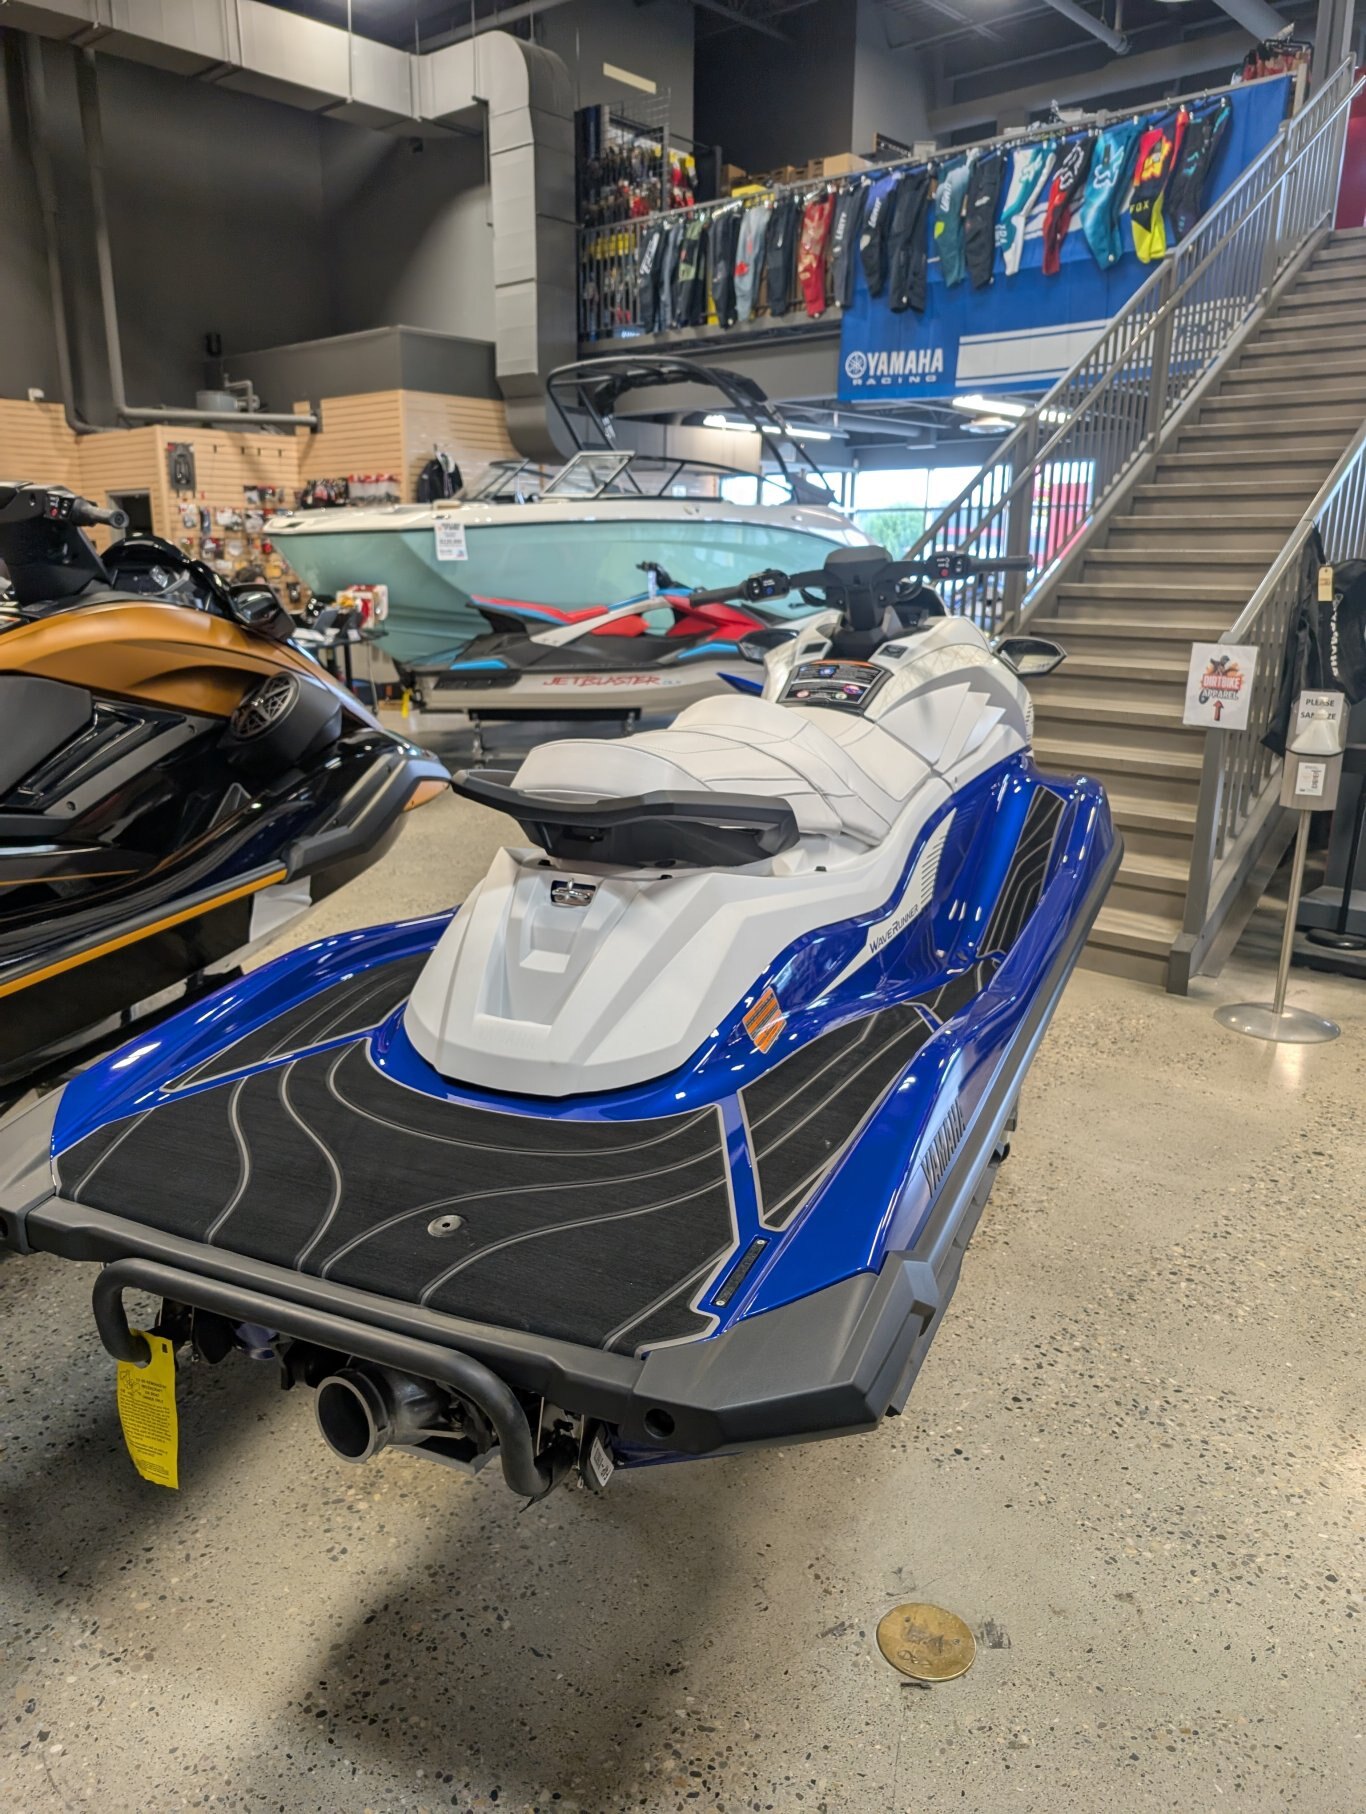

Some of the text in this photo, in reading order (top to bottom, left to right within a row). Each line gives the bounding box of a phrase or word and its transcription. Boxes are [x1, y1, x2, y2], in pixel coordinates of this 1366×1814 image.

[1130, 200, 1150, 213] FOX
[867, 348, 943, 376] YAMAHA
[852, 374, 938, 386] RACING
[543, 675, 661, 687] JETBLASTER
[1203, 674, 1241, 690] DIRTBIKE
[1203, 687, 1239, 701] APPAREL
[1305, 698, 1335, 707] PLEASE
[920, 1098, 966, 1199] YAMAHA
